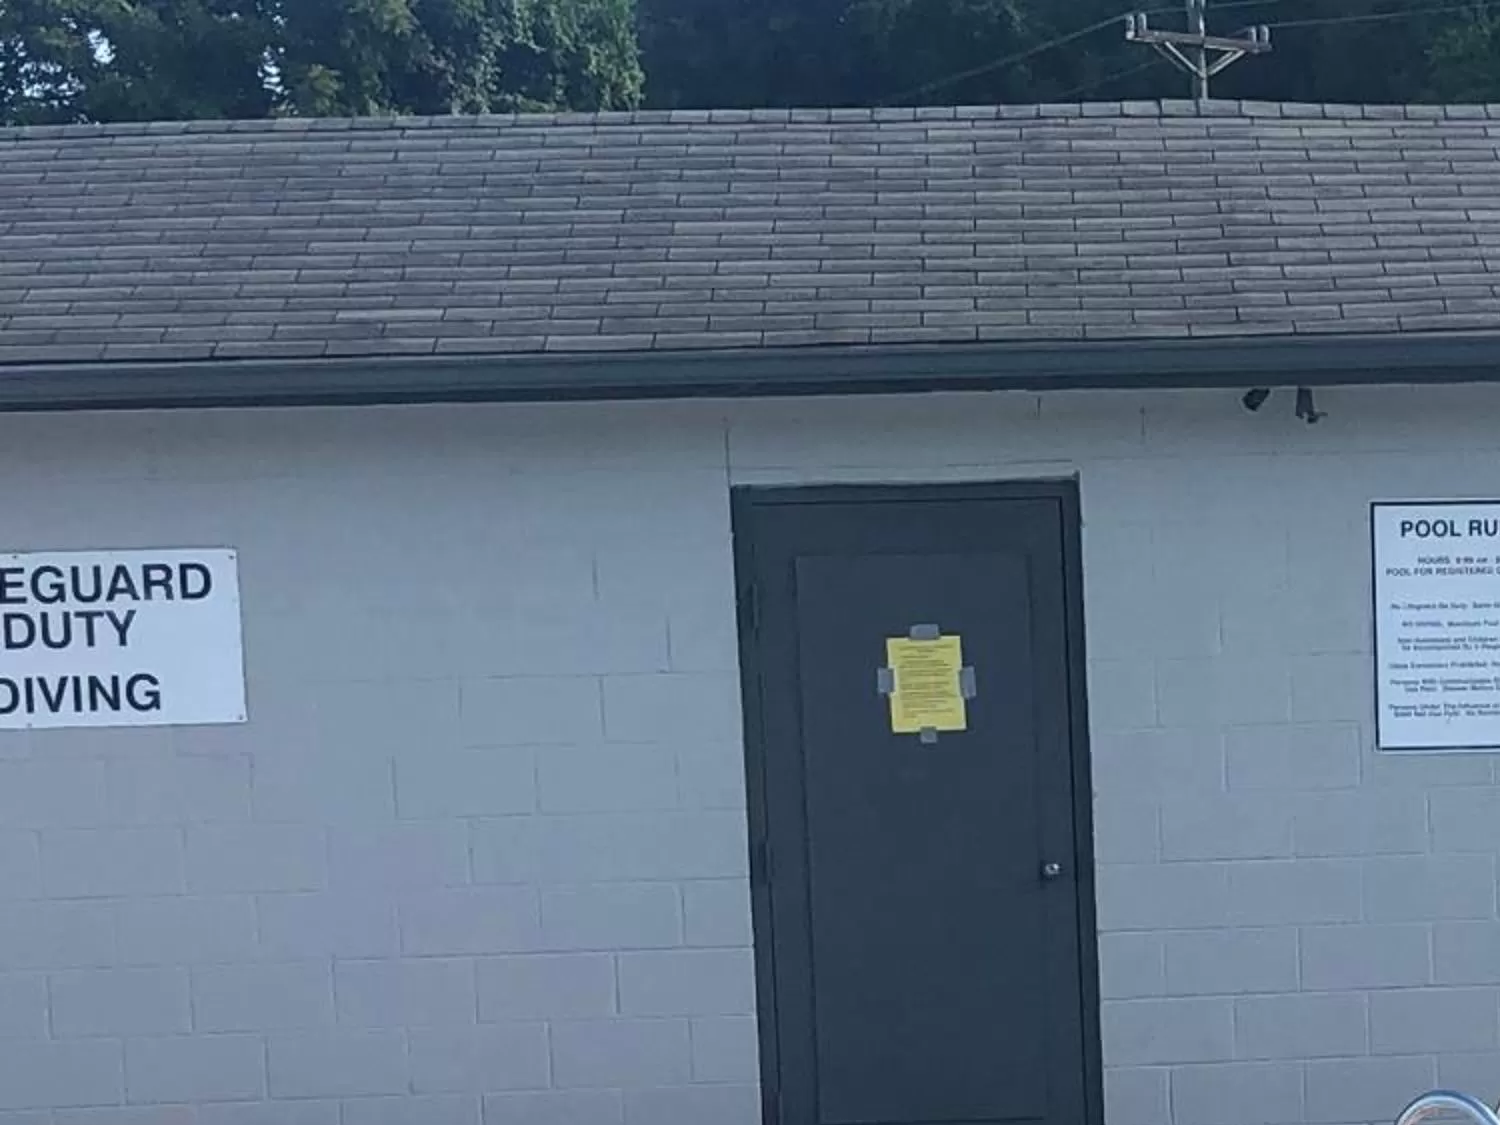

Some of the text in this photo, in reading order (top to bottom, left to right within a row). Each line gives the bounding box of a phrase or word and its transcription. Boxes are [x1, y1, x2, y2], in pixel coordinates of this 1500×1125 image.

[1400, 519, 1462, 538] POOL
[0, 563, 212, 604] EGUARD
[3, 609, 137, 650] DUTY
[0, 673, 161, 714] DIVING
